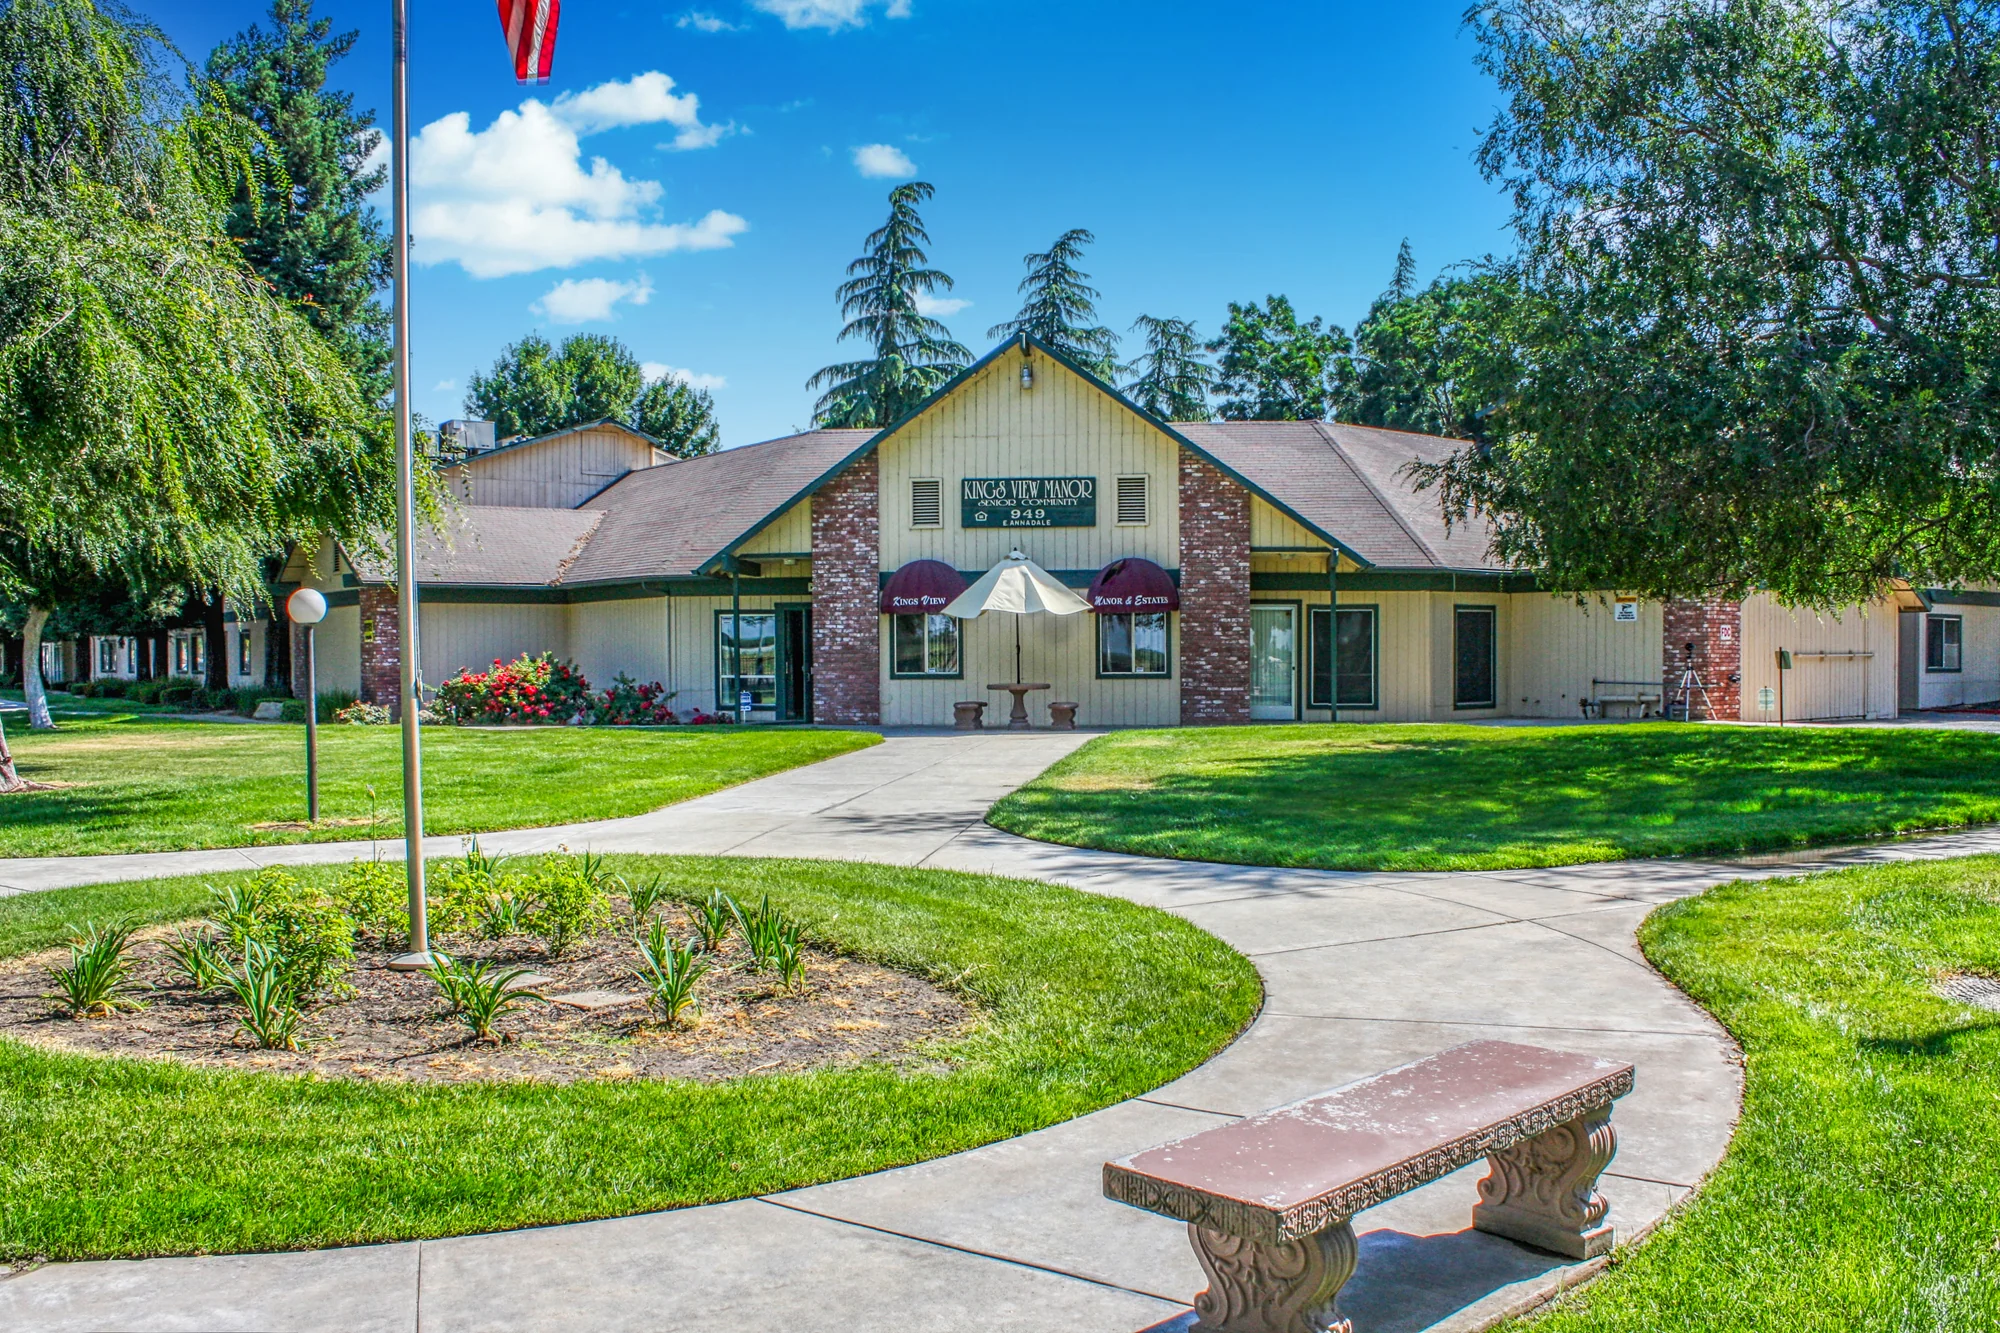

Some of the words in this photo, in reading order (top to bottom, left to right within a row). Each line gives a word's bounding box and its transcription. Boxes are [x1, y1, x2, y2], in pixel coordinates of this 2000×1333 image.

[964, 480, 1006, 499] KINGS
[1011, 480, 1040, 498] VIEW
[1044, 479, 1092, 498] MANOR
[1021, 498, 1078, 506] COMMUNITY
[1010, 509, 1045, 519] 949
[1125, 596, 1132, 605] &
